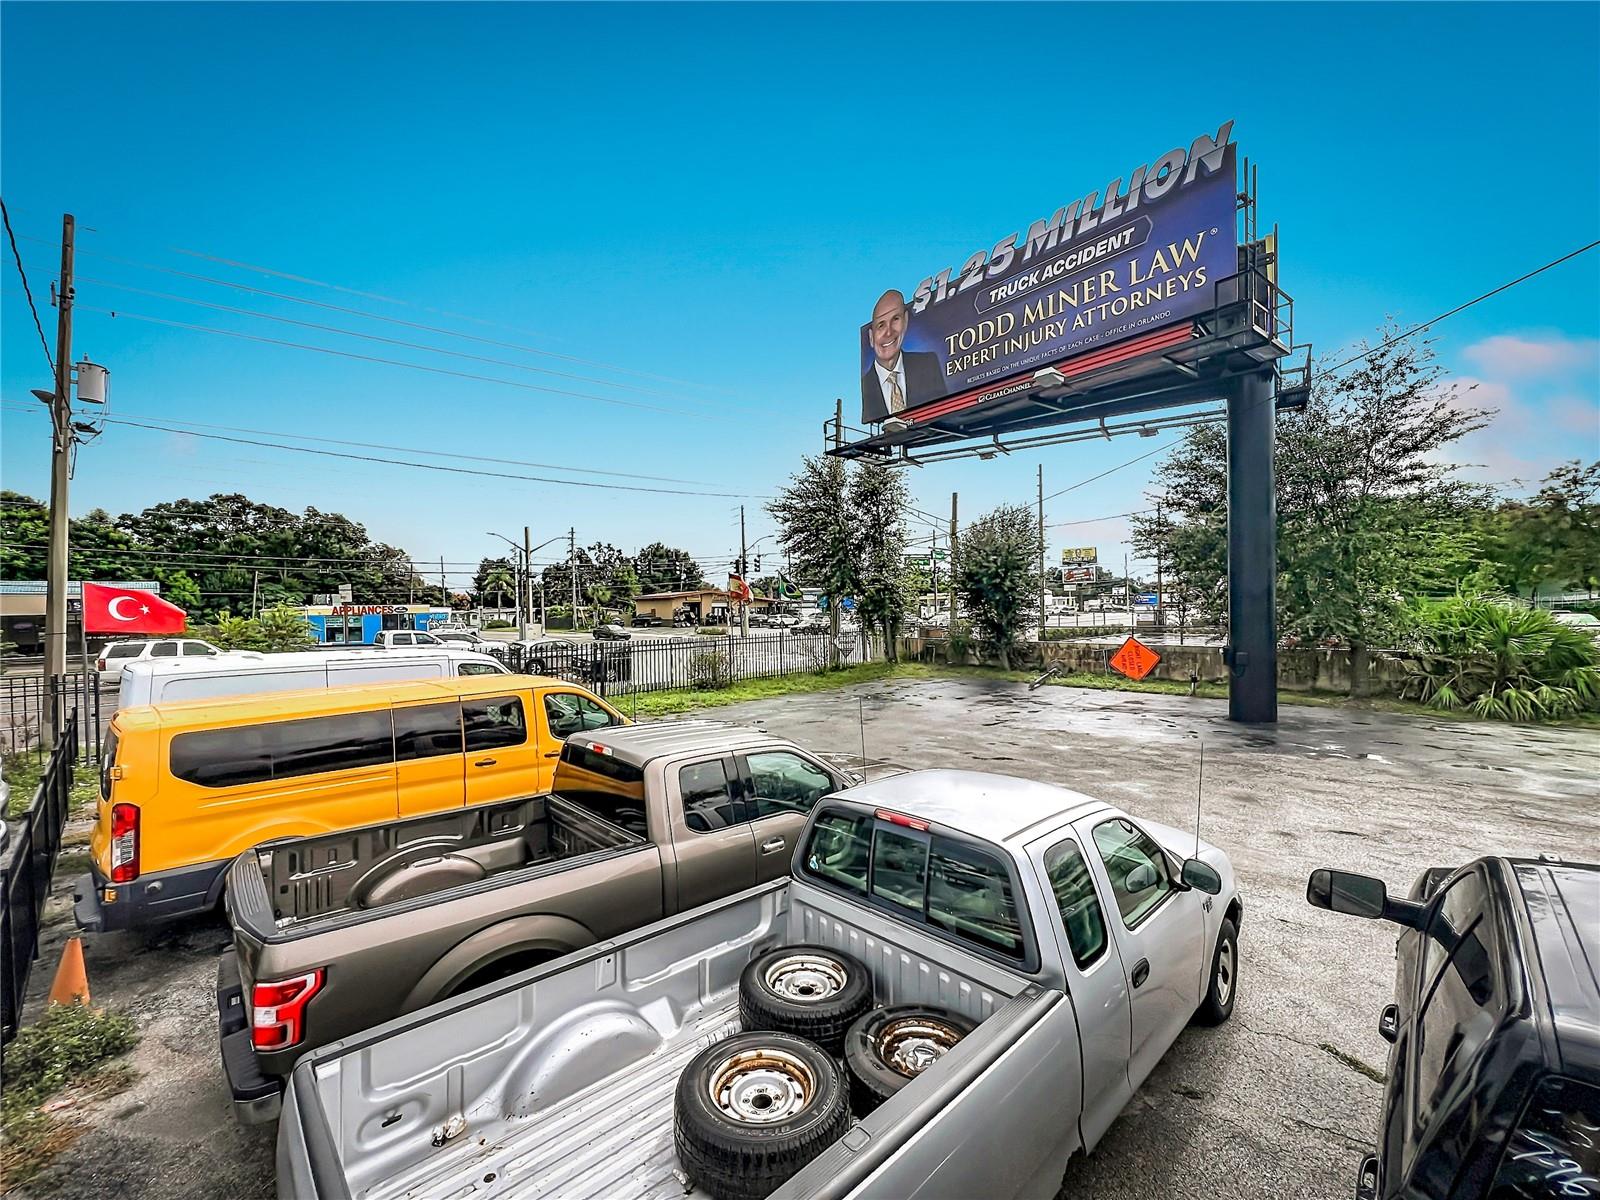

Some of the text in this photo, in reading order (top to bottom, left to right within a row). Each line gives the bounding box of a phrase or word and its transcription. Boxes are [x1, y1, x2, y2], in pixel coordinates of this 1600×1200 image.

[912, 119, 1235, 313] $1.25 MILLION
[945, 231, 1207, 357] TODD MINER LAW
[989, 227, 1136, 303] TRUCK ACCIDENT
[946, 266, 1207, 376] EXPERT INJURY ATTORNEYS
[967, 373, 986, 384] RESULTS
[986, 366, 1001, 377] BASED
[1010, 361, 1020, 369] THE
[1020, 354, 1040, 365] UNIQUE
[1041, 349, 1058, 359] FACTS
[1058, 345, 1067, 353] OF
[1068, 340, 1083, 350] EACH
[1084, 334, 1100, 344] CASE
[1105, 325, 1127, 337] OFFICE
[1137, 310, 1171, 326] ORLANDO
[331, 605, 394, 615] APPLIANCES
